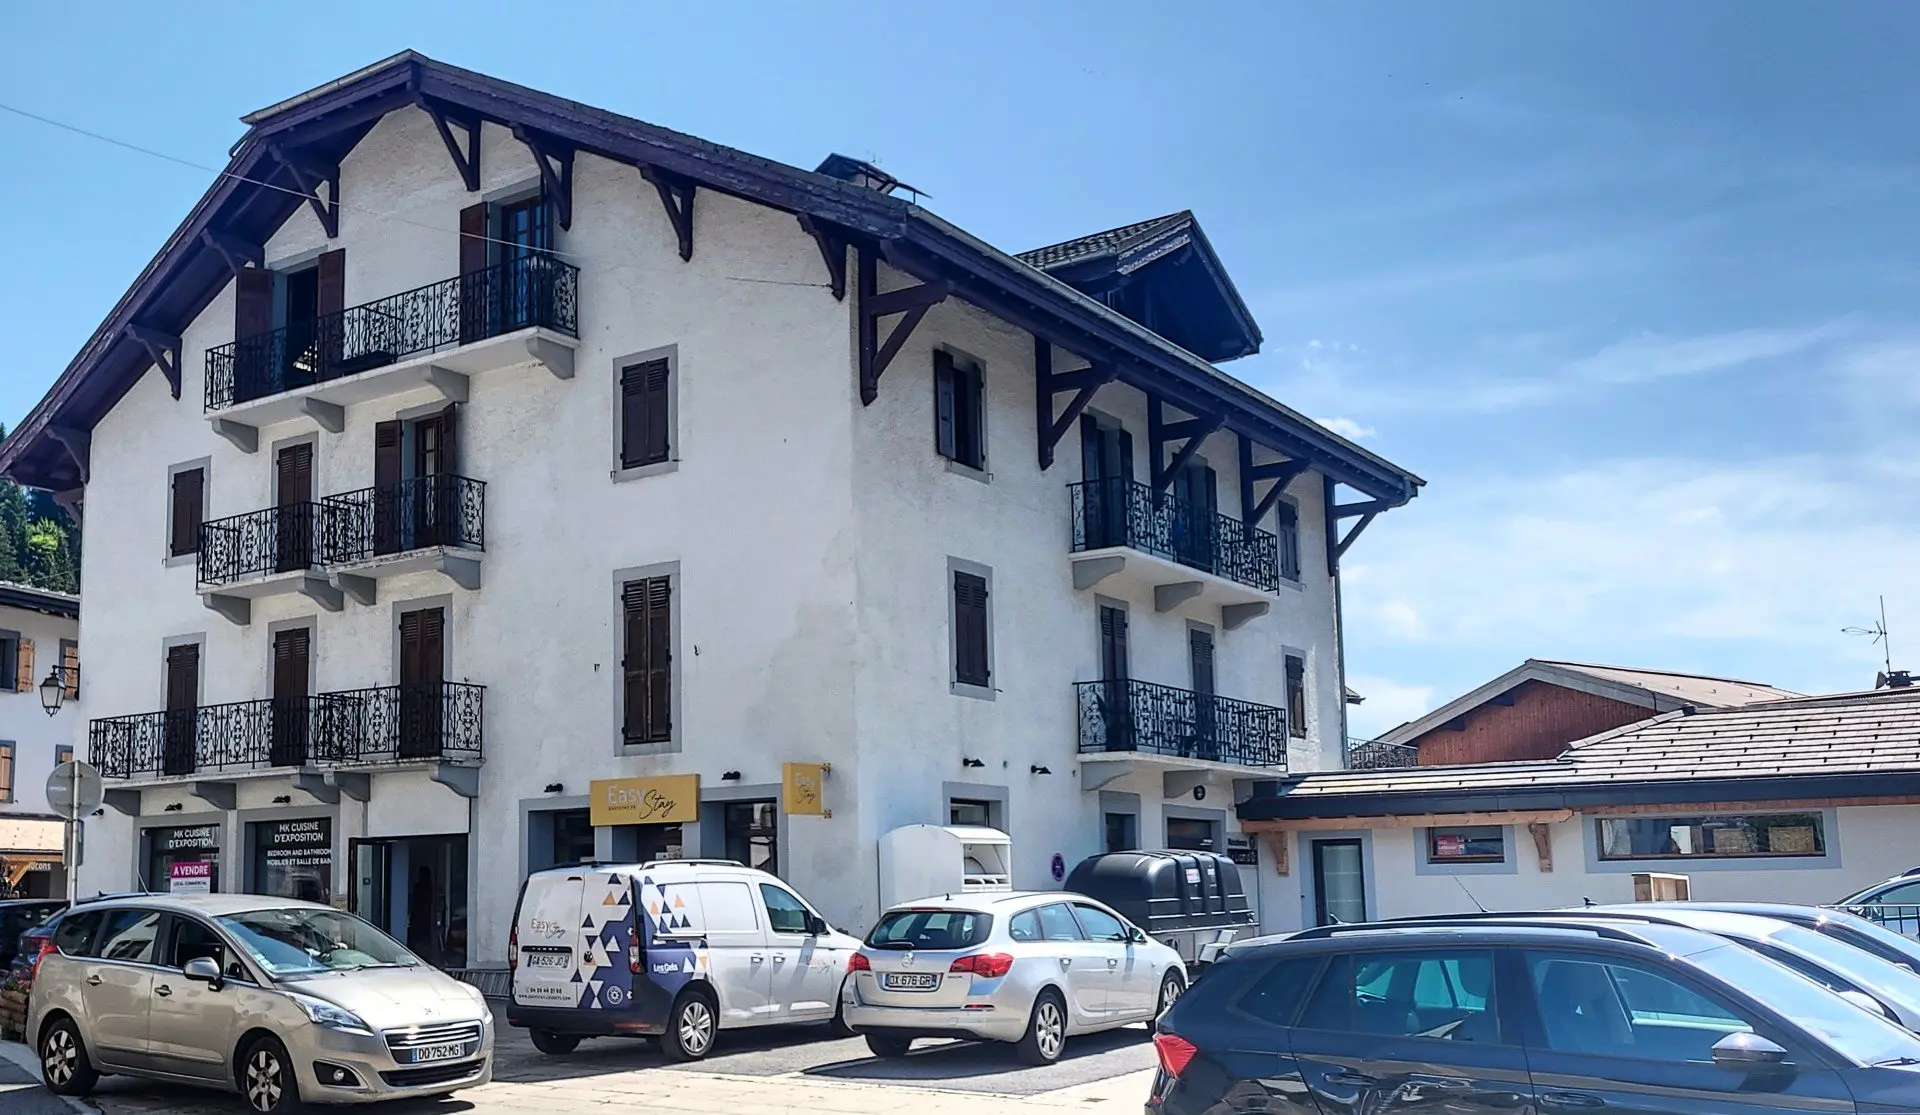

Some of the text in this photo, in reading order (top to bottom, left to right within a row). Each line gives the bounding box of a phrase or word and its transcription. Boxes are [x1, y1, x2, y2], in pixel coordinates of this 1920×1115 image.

[607, 784, 646, 804] Easy
[639, 788, 677, 819] Stay
[173, 827, 211, 838] MK CUISINE
[279, 821, 320, 833] MK CUISINE
[168, 838, 214, 848] D'EXPOSITION
[274, 832, 324, 843] D'EXPOSITION
[180, 865, 209, 876] VENDRE
[889, 974, 932, 986] DX-676-GR
